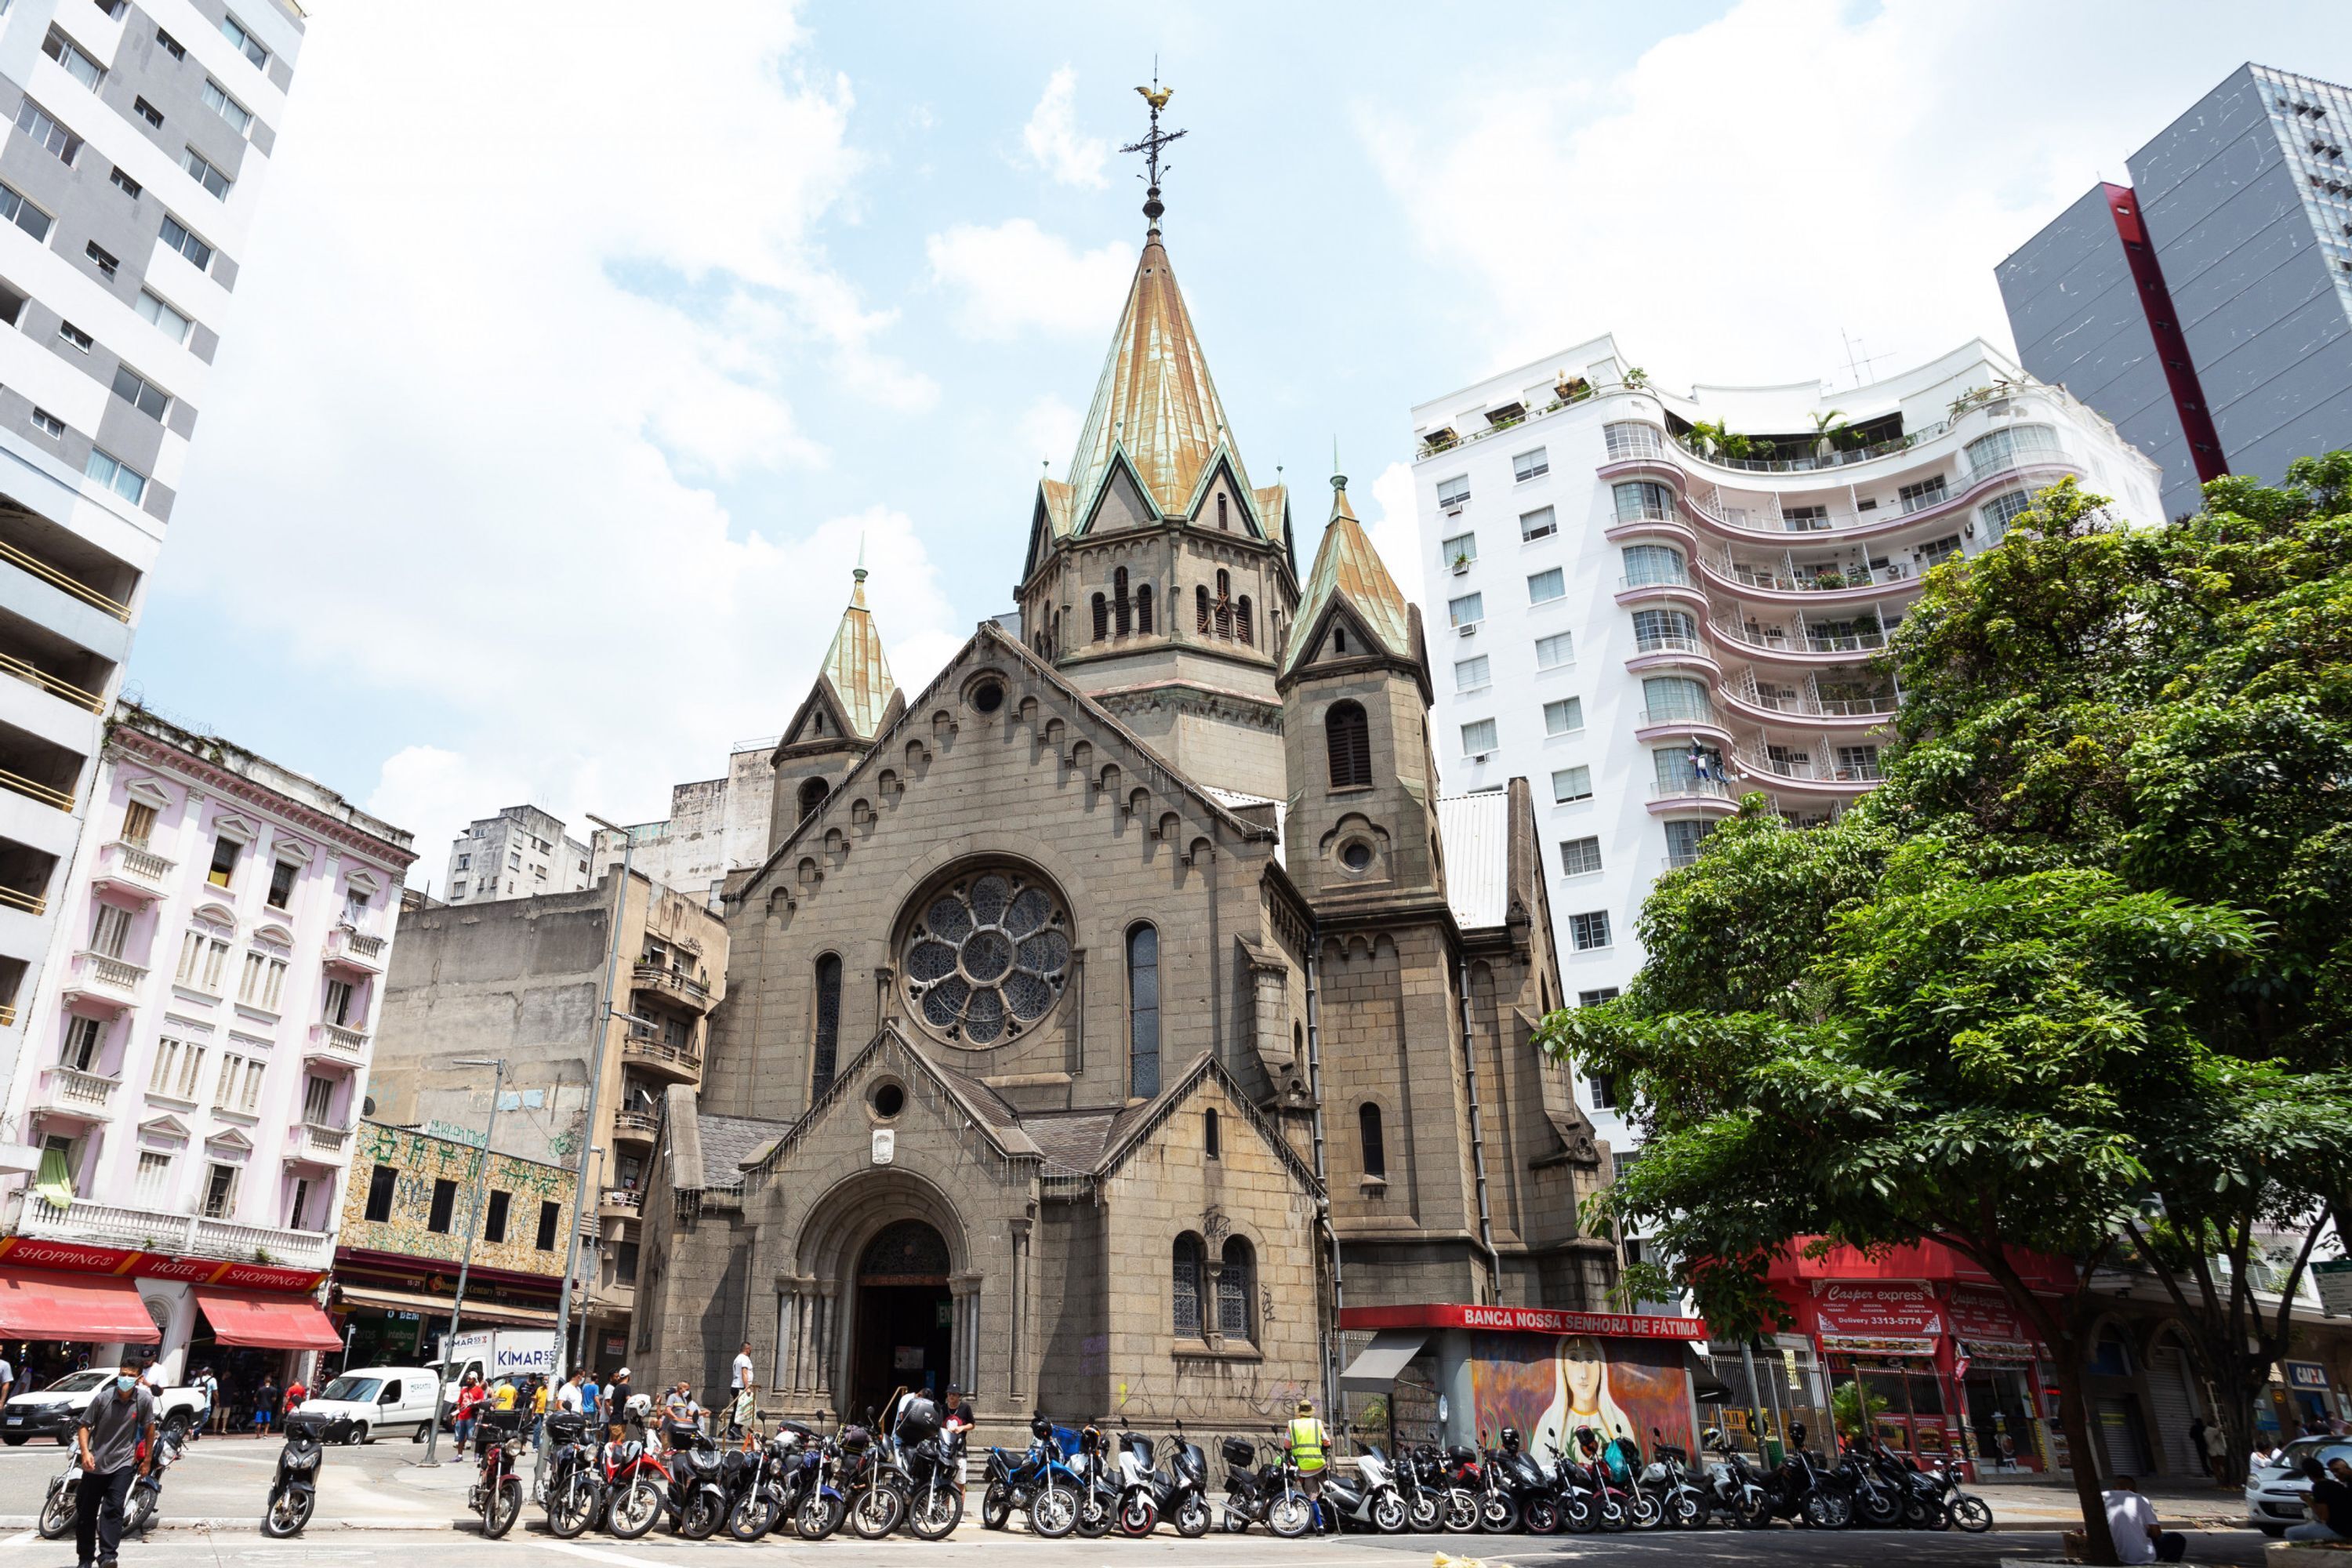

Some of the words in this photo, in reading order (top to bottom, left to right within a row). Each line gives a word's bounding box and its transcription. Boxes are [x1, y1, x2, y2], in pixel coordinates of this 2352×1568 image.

[13, 1247, 100, 1265] SHOPPING
[150, 1261, 198, 1276] HOTEL
[228, 1270, 298, 1287] SHOPPING
[434, 1276, 469, 1293] Shoppg
[1828, 1286, 1874, 1301] Casper
[1877, 1290, 1924, 1302] express
[1464, 1308, 1513, 1326] BANCA
[1516, 1312, 1562, 1329] NOSSA
[1565, 1315, 1628, 1333] SENHORA
[1632, 1319, 1649, 1334] DE
[1653, 1318, 1699, 1335] FÁTIMA
[1871, 1316, 1922, 1325] 3313-5774
[445, 1338, 473, 1349] KMAR
[498, 1346, 543, 1366] KIMAR
[2296, 1367, 2326, 1385] CAIXA
